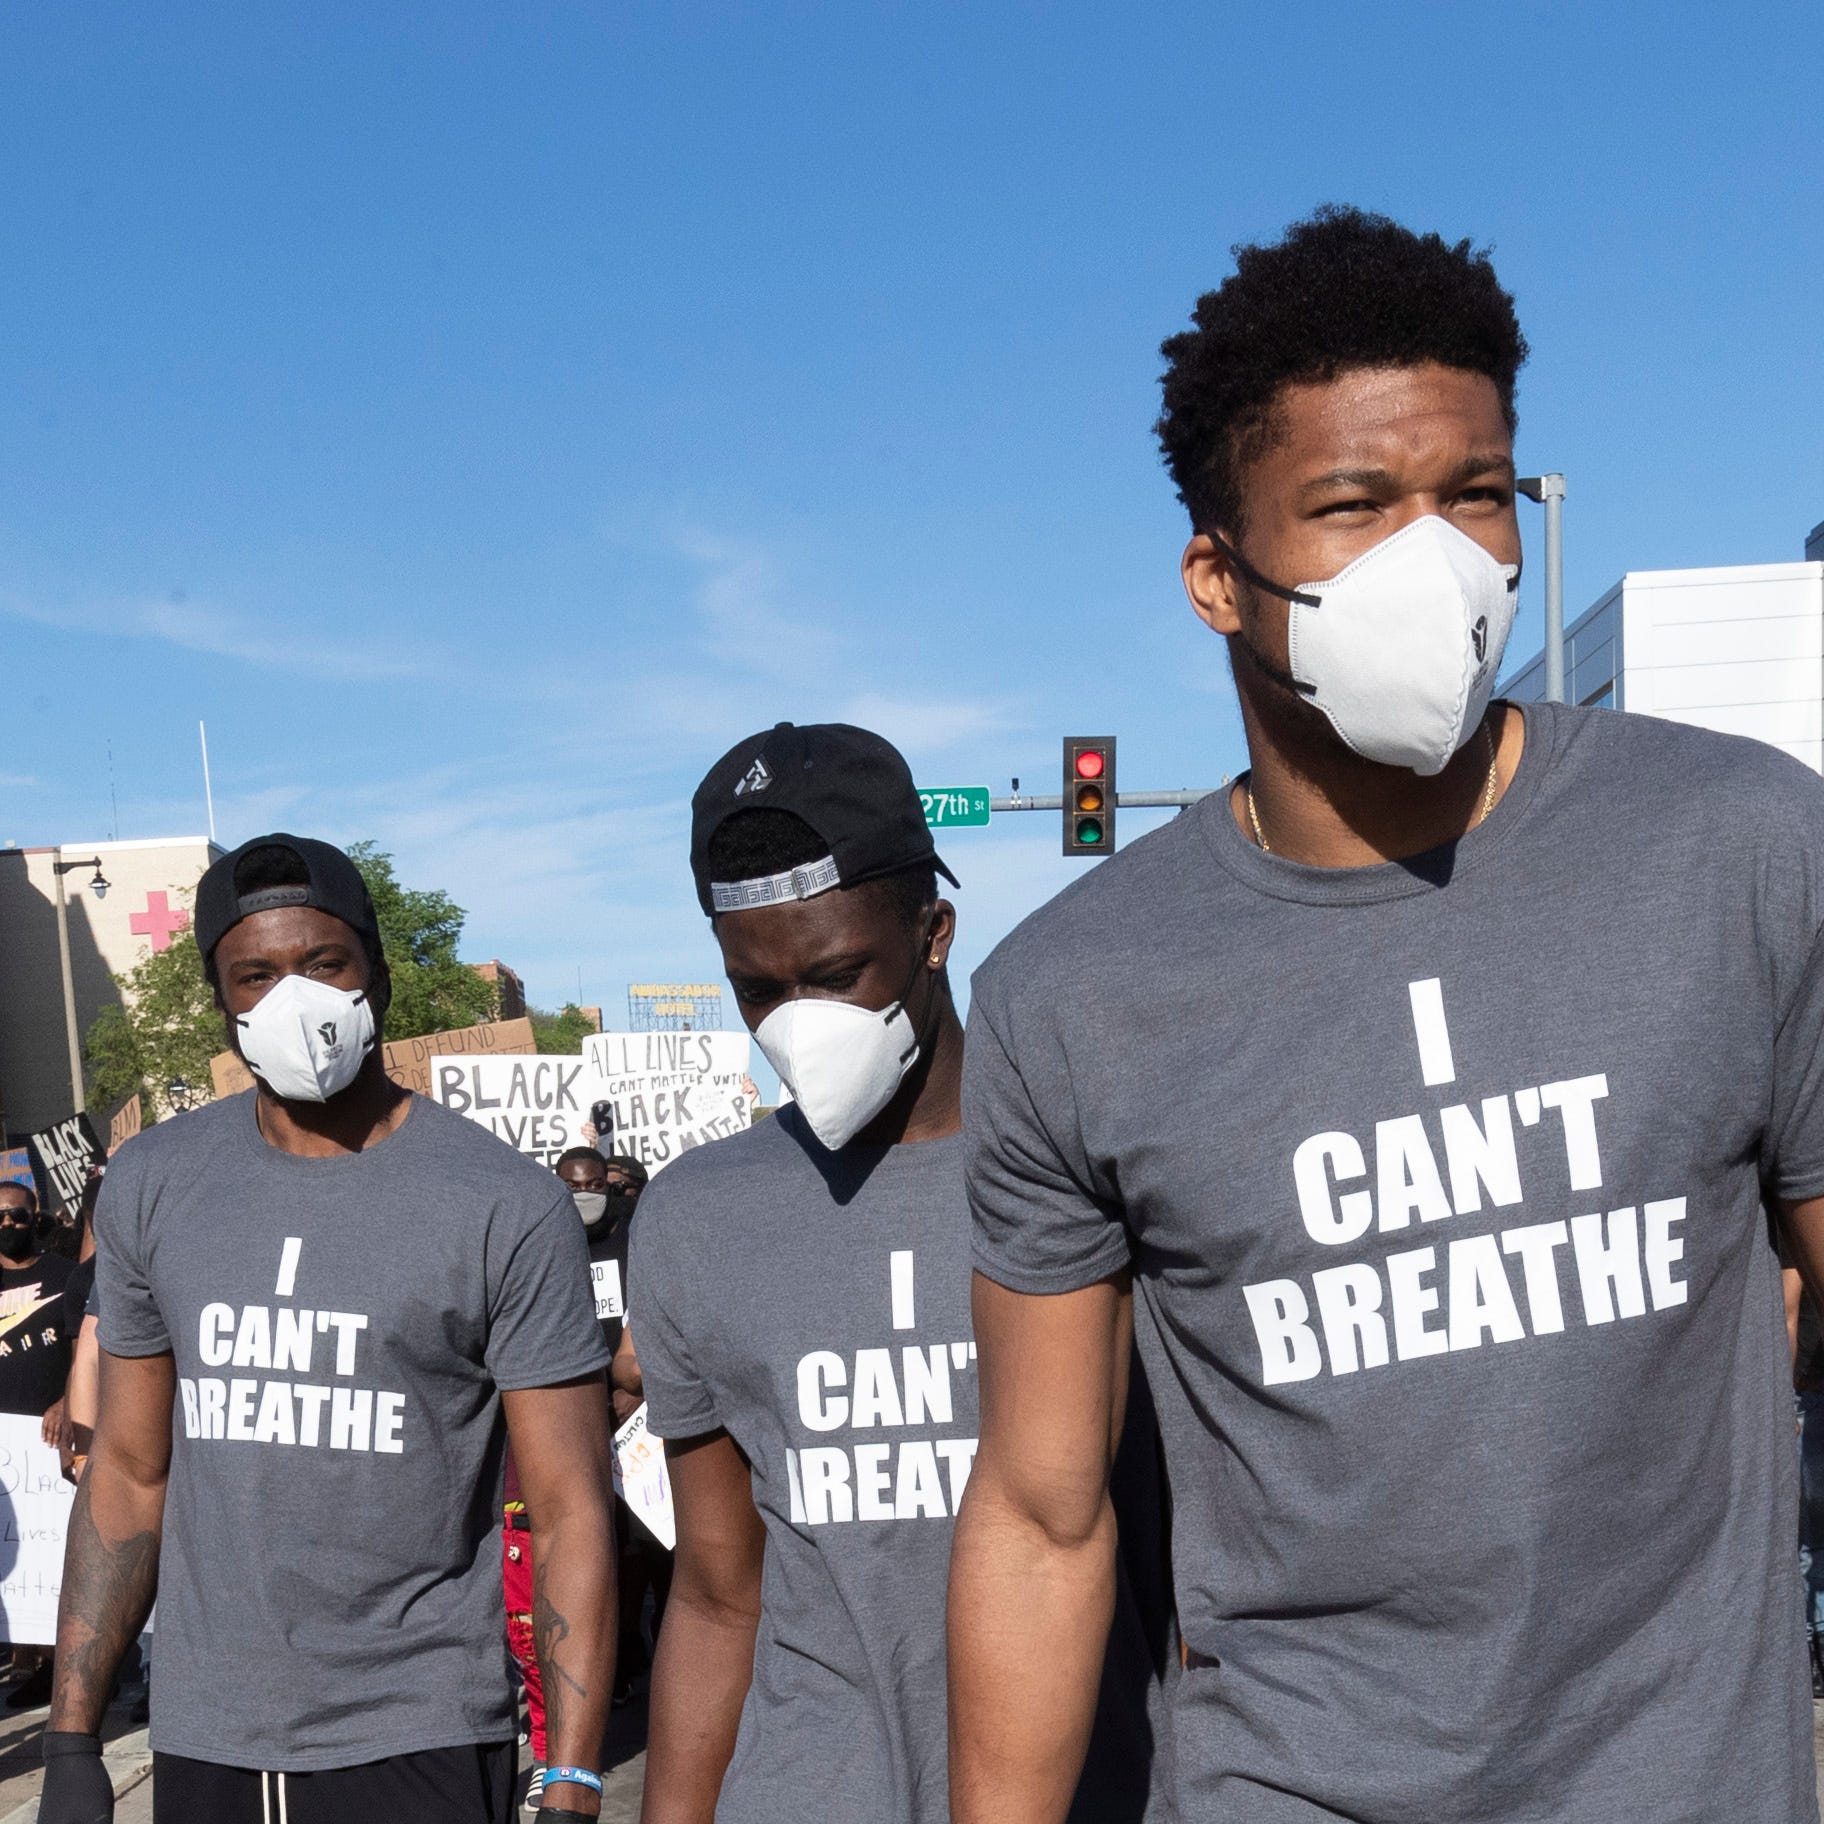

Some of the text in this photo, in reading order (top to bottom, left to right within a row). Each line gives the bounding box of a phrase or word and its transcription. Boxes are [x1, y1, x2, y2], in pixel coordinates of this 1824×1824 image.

[919, 793, 984, 823] 27th St
[656, 1002, 695, 1016] HOTEL
[1408, 977, 1456, 1086] I
[412, 1026, 496, 1062] DEFUND
[592, 1035, 712, 1078] ALL LIVES
[440, 1062, 583, 1114] BLACK
[592, 1086, 694, 1136] BLACK
[610, 1078, 645, 1095] CANT
[651, 1074, 703, 1091] MATTER
[31, 1116, 94, 1170] BLACK
[111, 1105, 137, 1148] BLM
[490, 1115, 568, 1149] IVES
[1292, 1073, 1609, 1245] CAN'T
[275, 1236, 302, 1296] I
[890, 1250, 915, 1330] I
[1242, 1196, 1688, 1386] BREATHE
[199, 1302, 368, 1376] CAN'T
[796, 1341, 978, 1432] CAN'
[180, 1378, 406, 1454] BREATHE
